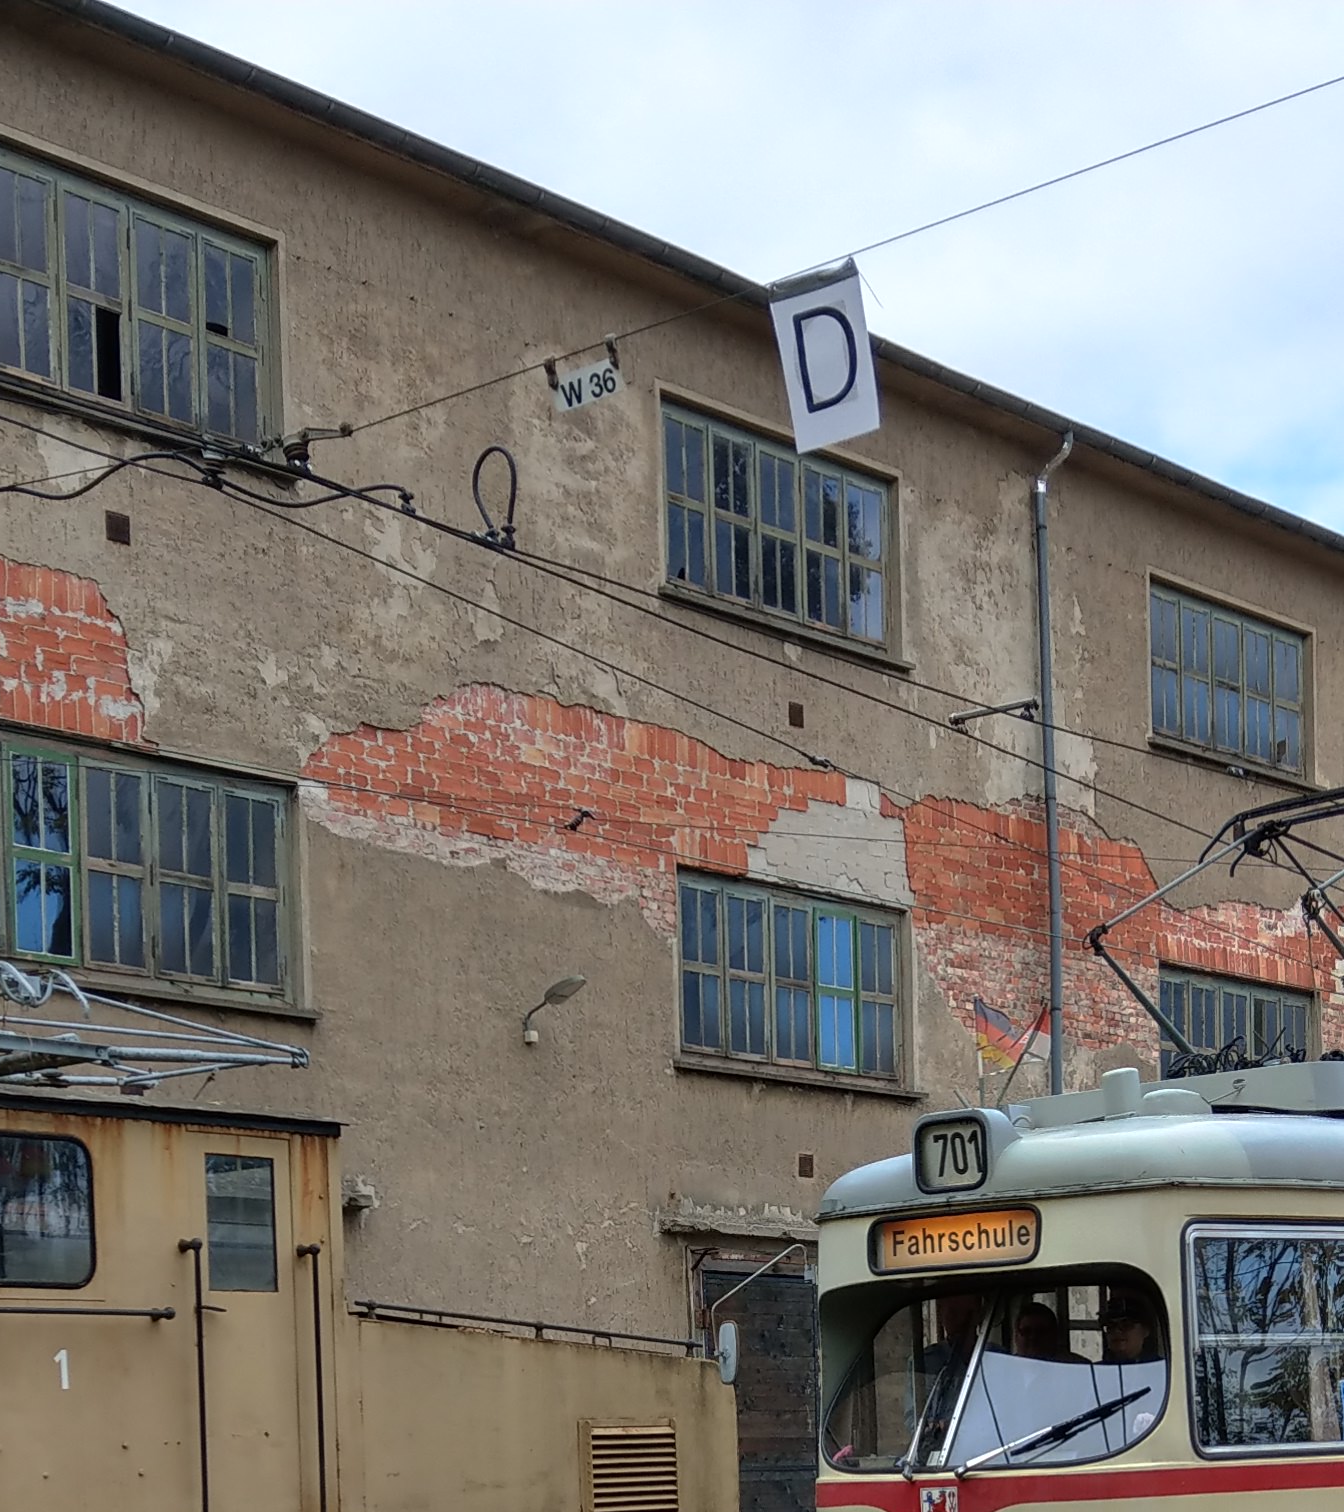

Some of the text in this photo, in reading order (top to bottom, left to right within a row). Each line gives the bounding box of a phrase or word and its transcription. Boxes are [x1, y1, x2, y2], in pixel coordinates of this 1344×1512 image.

[793, 306, 858, 414] D
[560, 367, 617, 407] W 36
[933, 1130, 983, 1177] 701
[891, 1219, 1032, 1259] Fahrschule
[54, 1348, 71, 1390] 1
